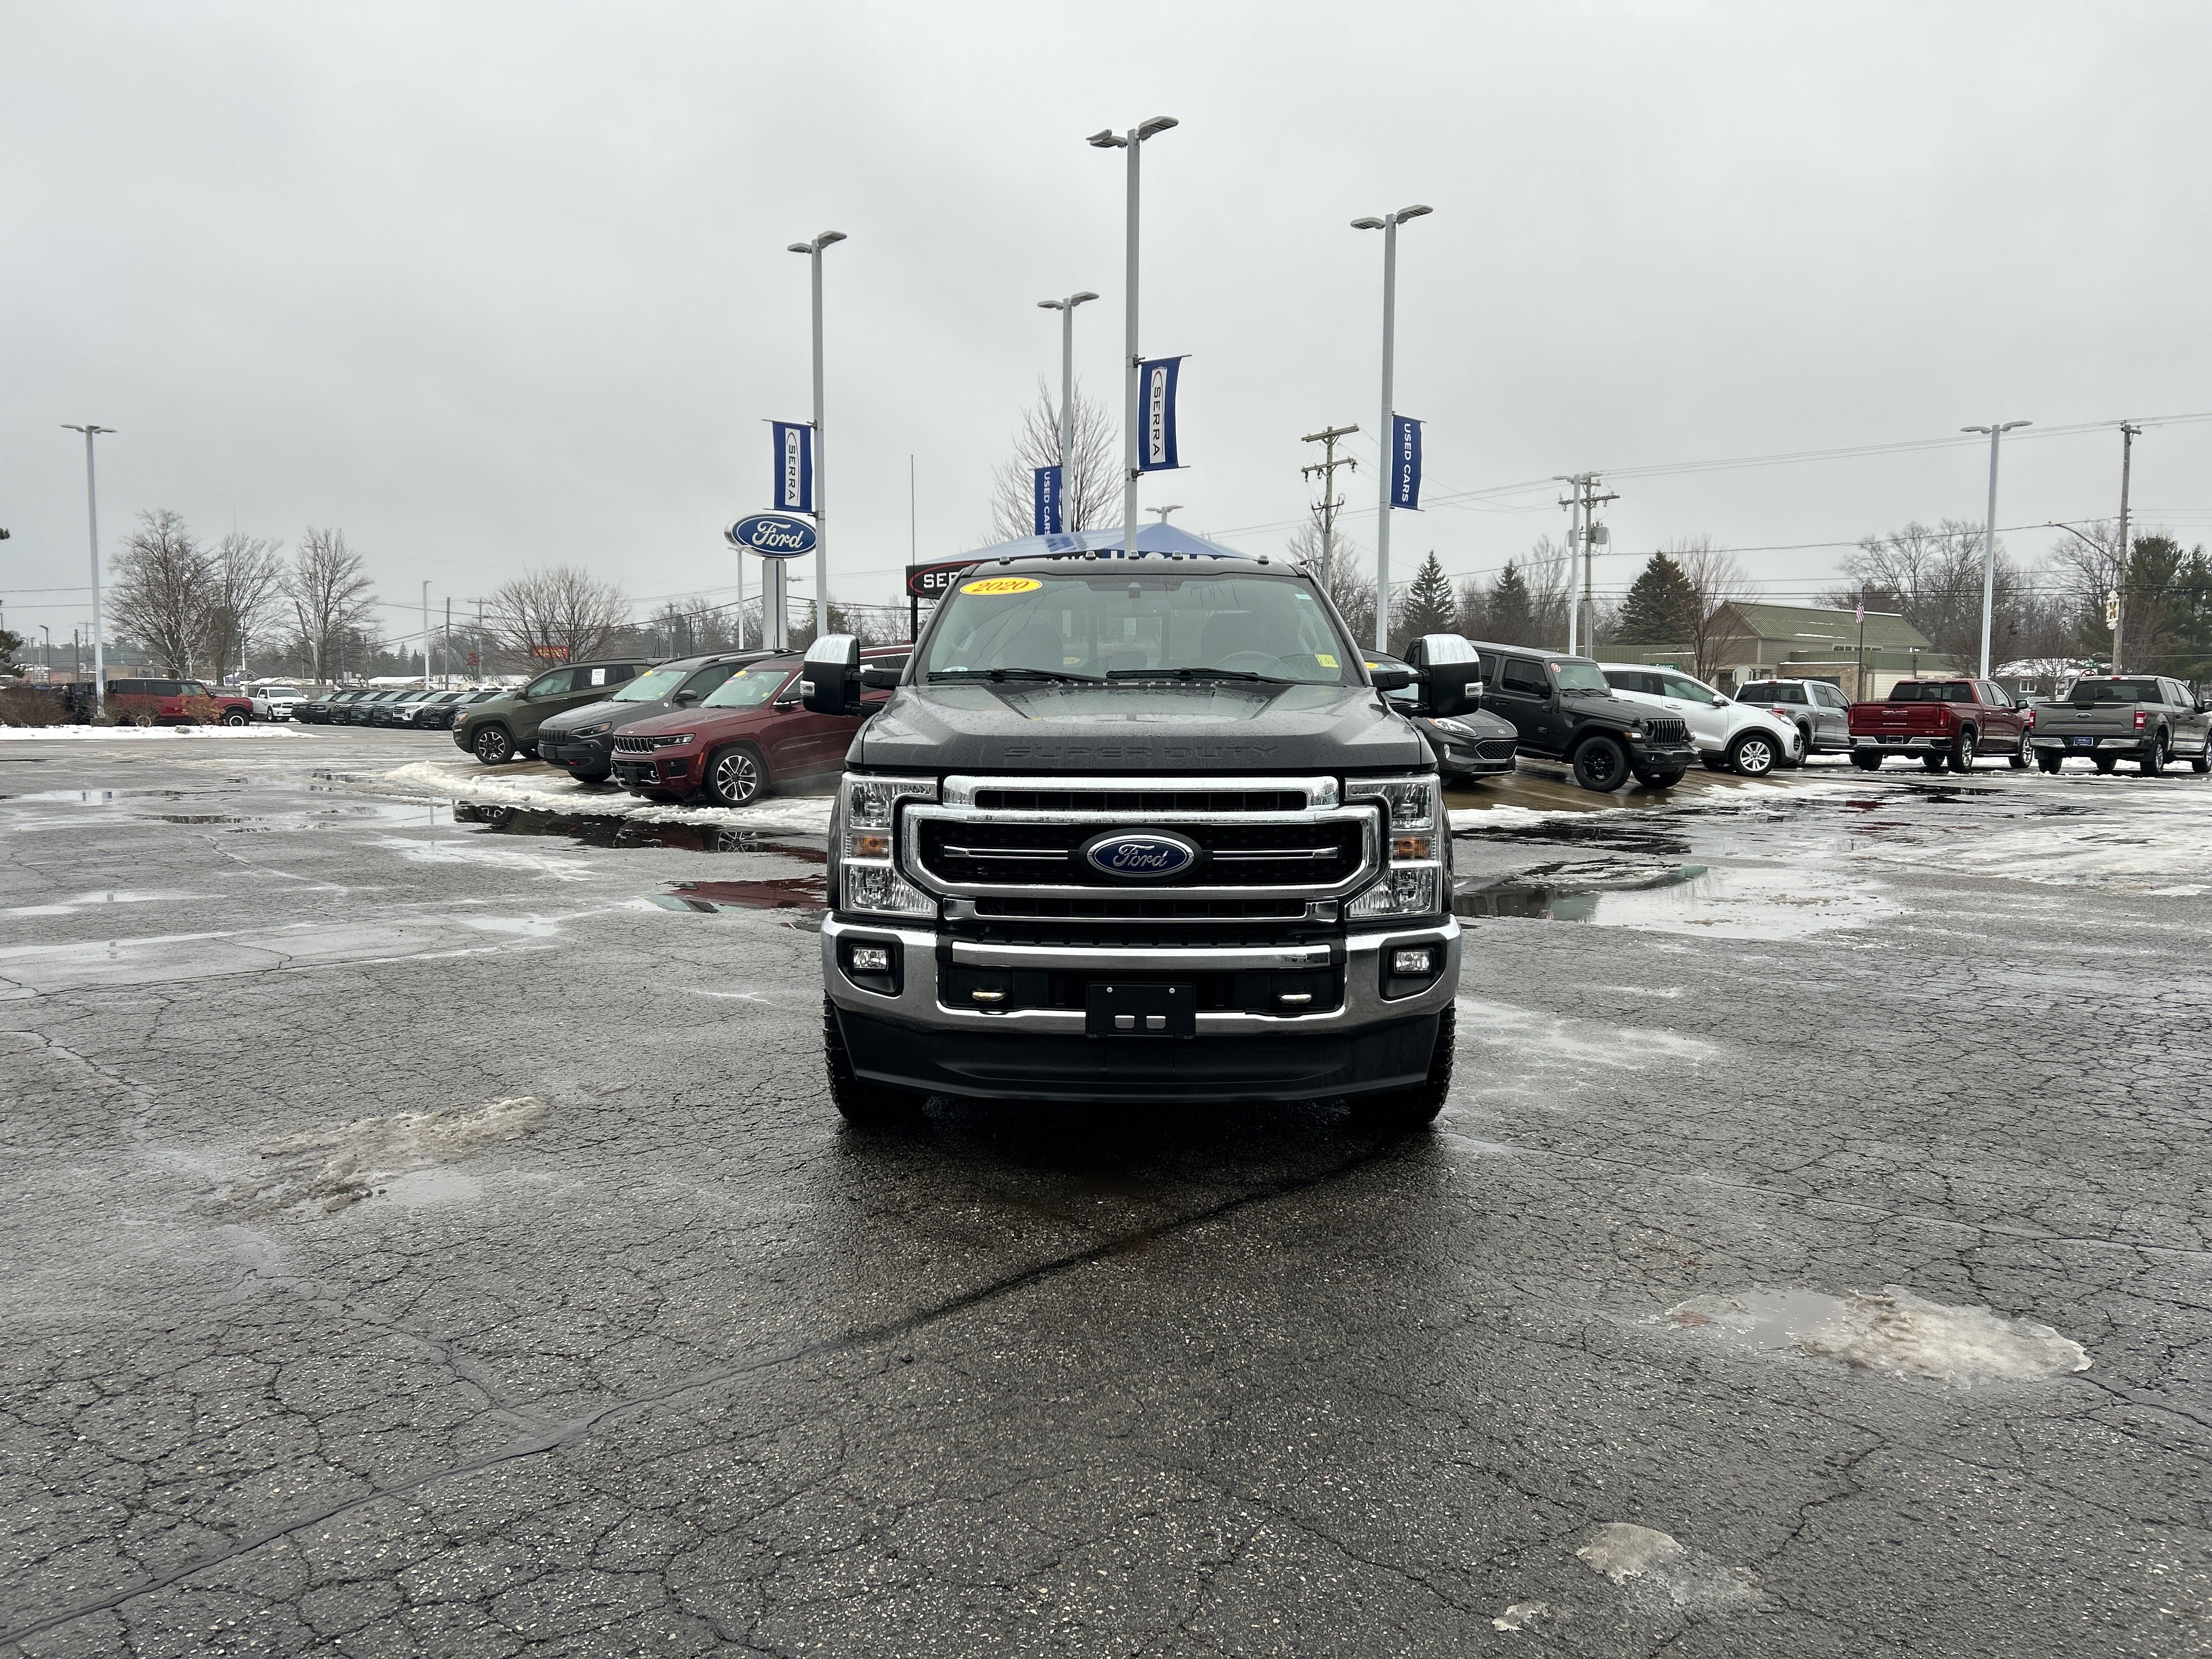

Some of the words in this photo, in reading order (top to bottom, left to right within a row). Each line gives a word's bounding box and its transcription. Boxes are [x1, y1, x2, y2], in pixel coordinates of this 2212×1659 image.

[1153, 386, 1161, 456] SERRA
[1402, 464, 1411, 502] CARS
[752, 521, 804, 548] Ford
[972, 580, 1030, 592] 2020
[1003, 746, 1153, 759] SUPER
[1164, 746, 1278, 759] DUTY
[1113, 844, 1169, 867] Ford
